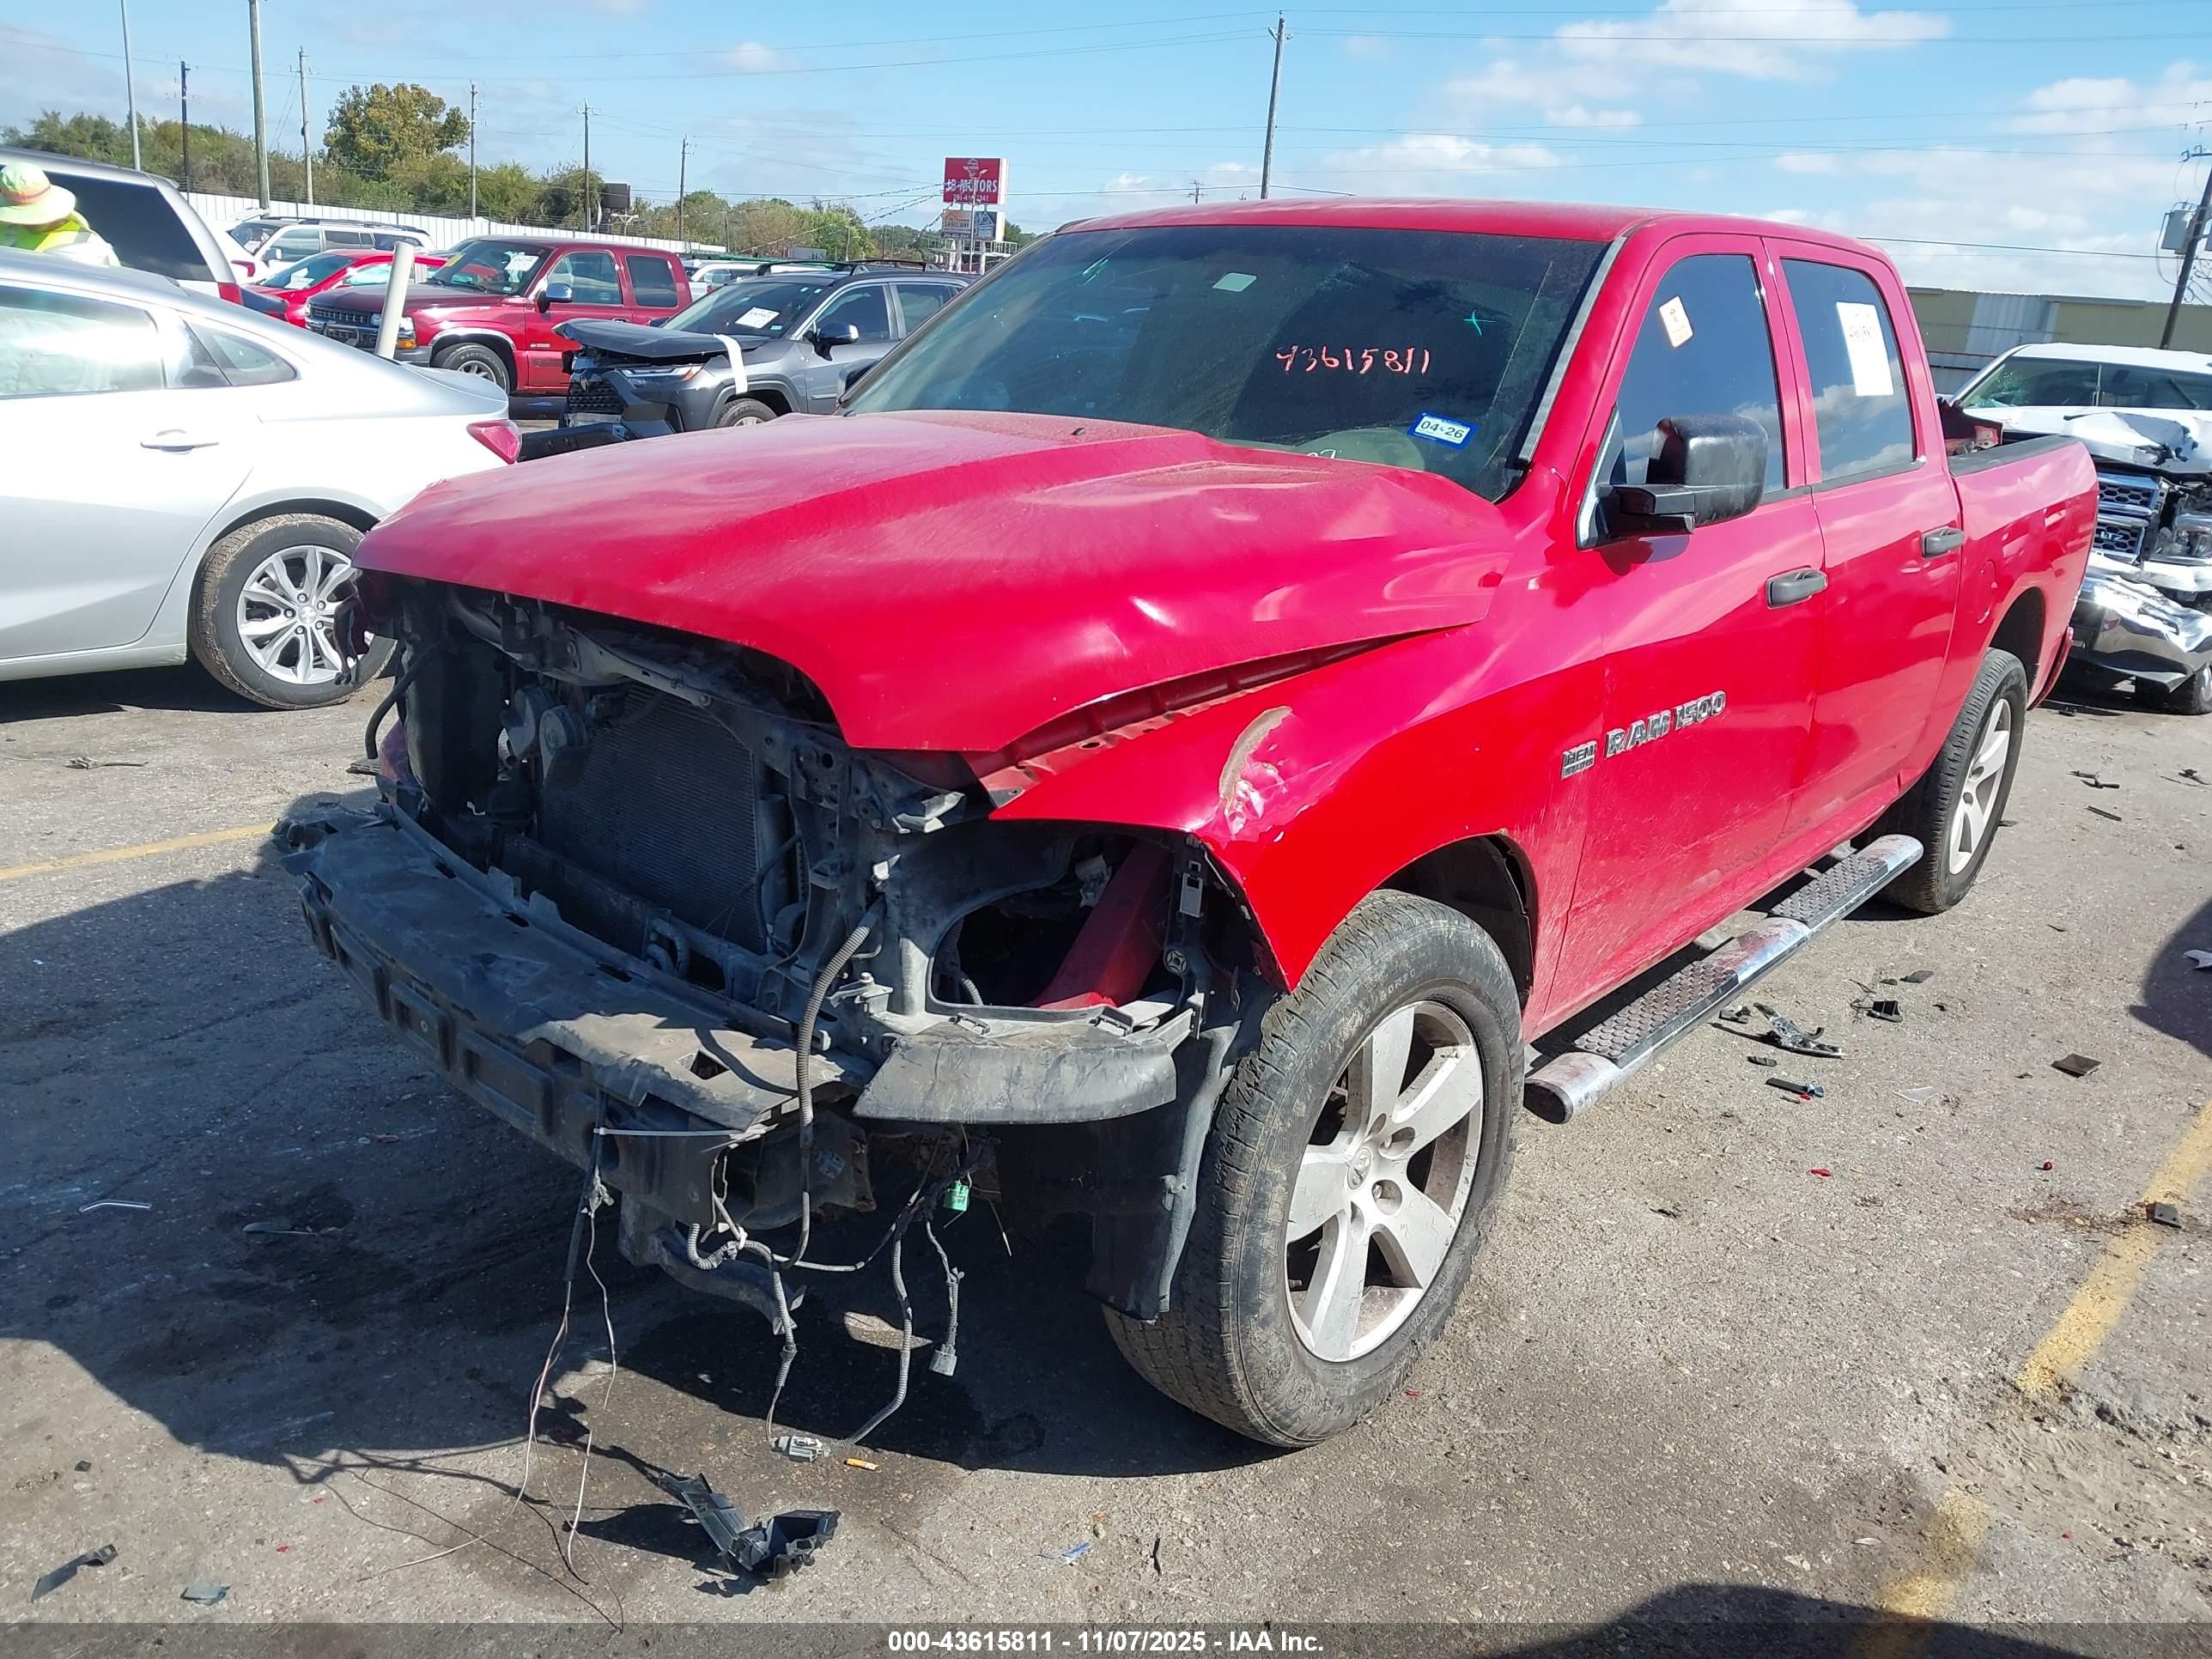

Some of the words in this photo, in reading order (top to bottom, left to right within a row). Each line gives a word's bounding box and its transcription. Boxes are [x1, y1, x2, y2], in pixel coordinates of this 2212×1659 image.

[960, 179, 998, 193] MOTORS
[1276, 343, 1430, 374] 43615811
[1420, 420, 1439, 432] 04
[1444, 427, 1465, 439] 26
[2100, 531, 2124, 541] LTZ
[1606, 710, 1671, 757] RAM
[1674, 690, 1726, 729] 1500
[1563, 741, 1597, 767] HEMI
